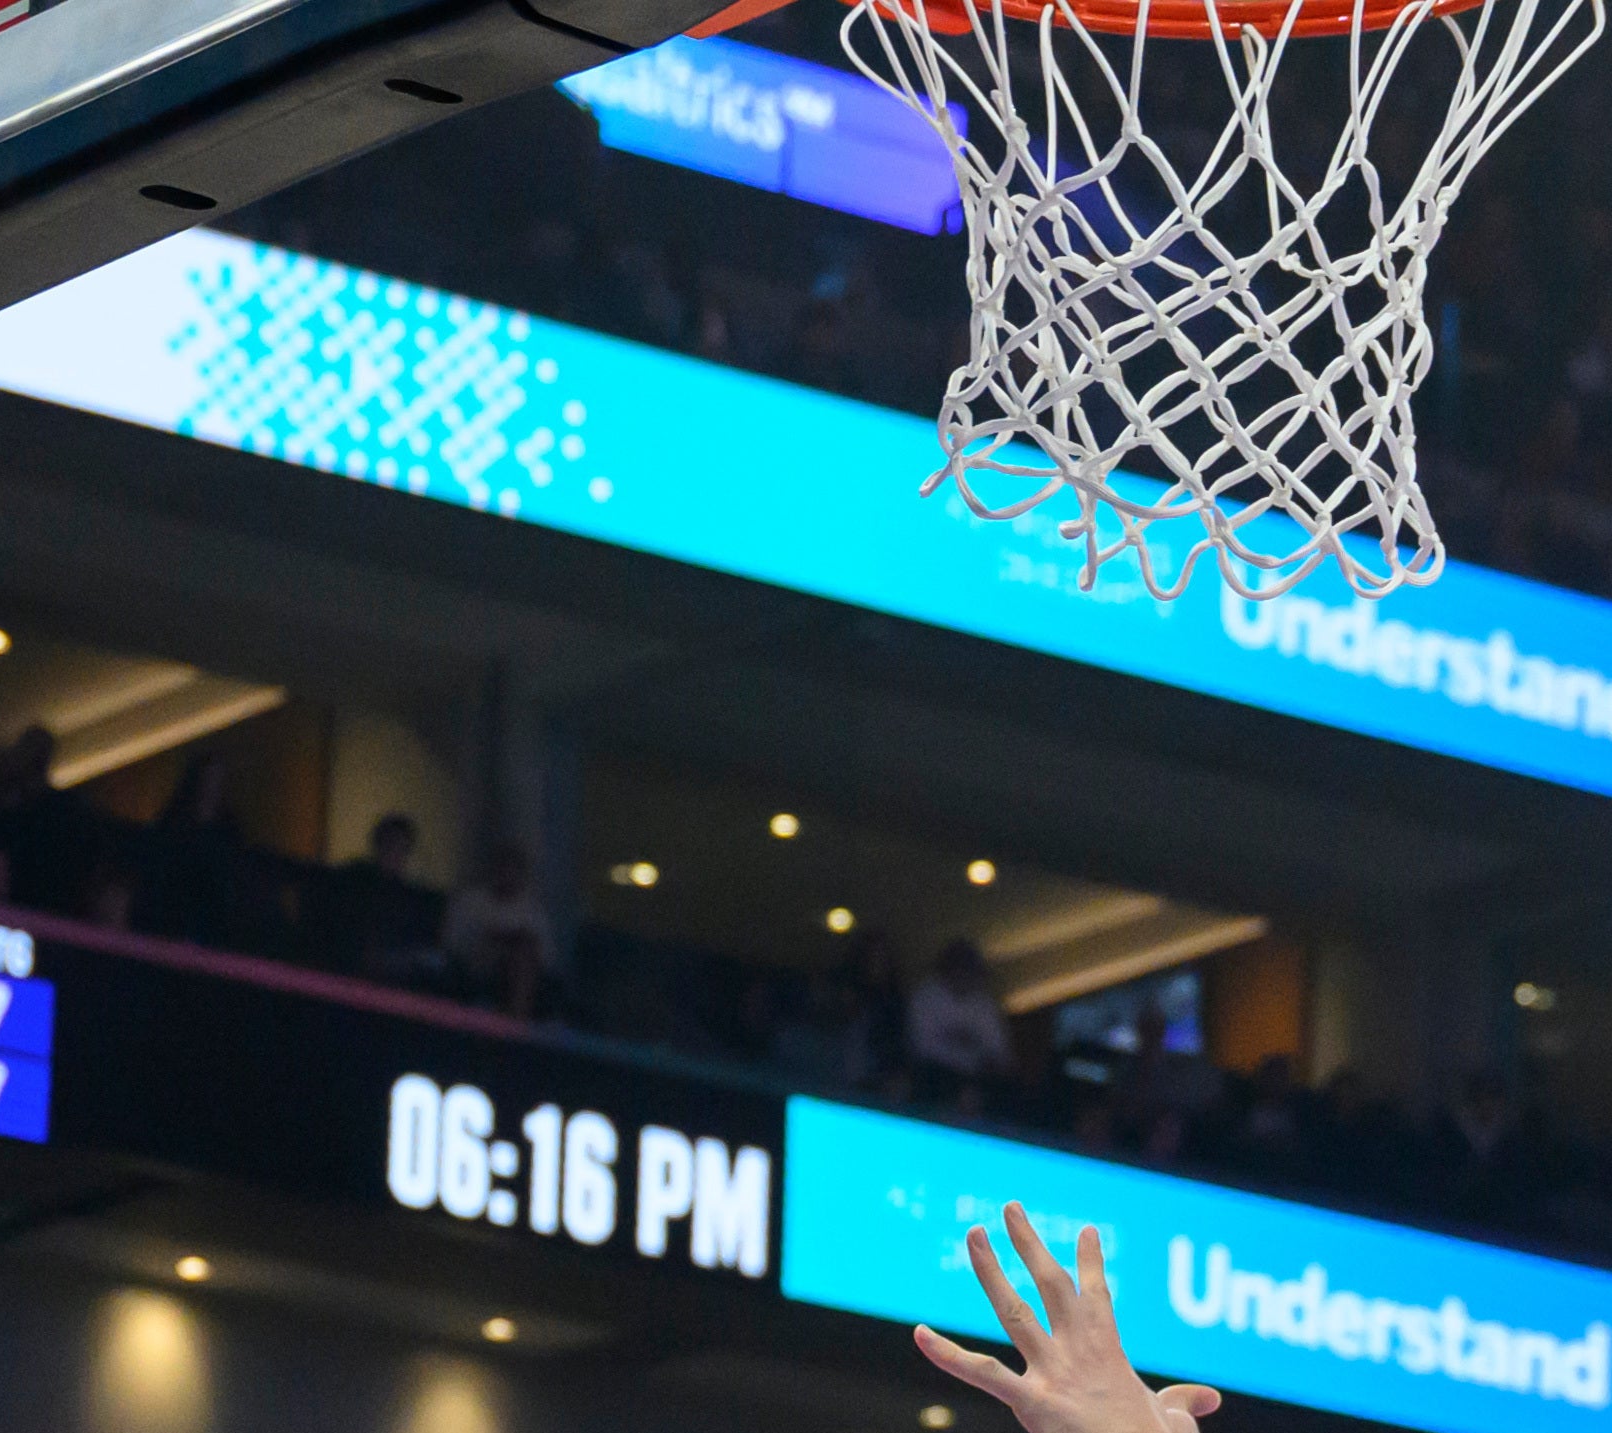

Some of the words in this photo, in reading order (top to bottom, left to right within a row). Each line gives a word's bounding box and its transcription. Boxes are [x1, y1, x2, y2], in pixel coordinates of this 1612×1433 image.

[388, 1073, 616, 1245] 06:16
[636, 1124, 771, 1278] PM
[1168, 1234, 1611, 1410] Understand
